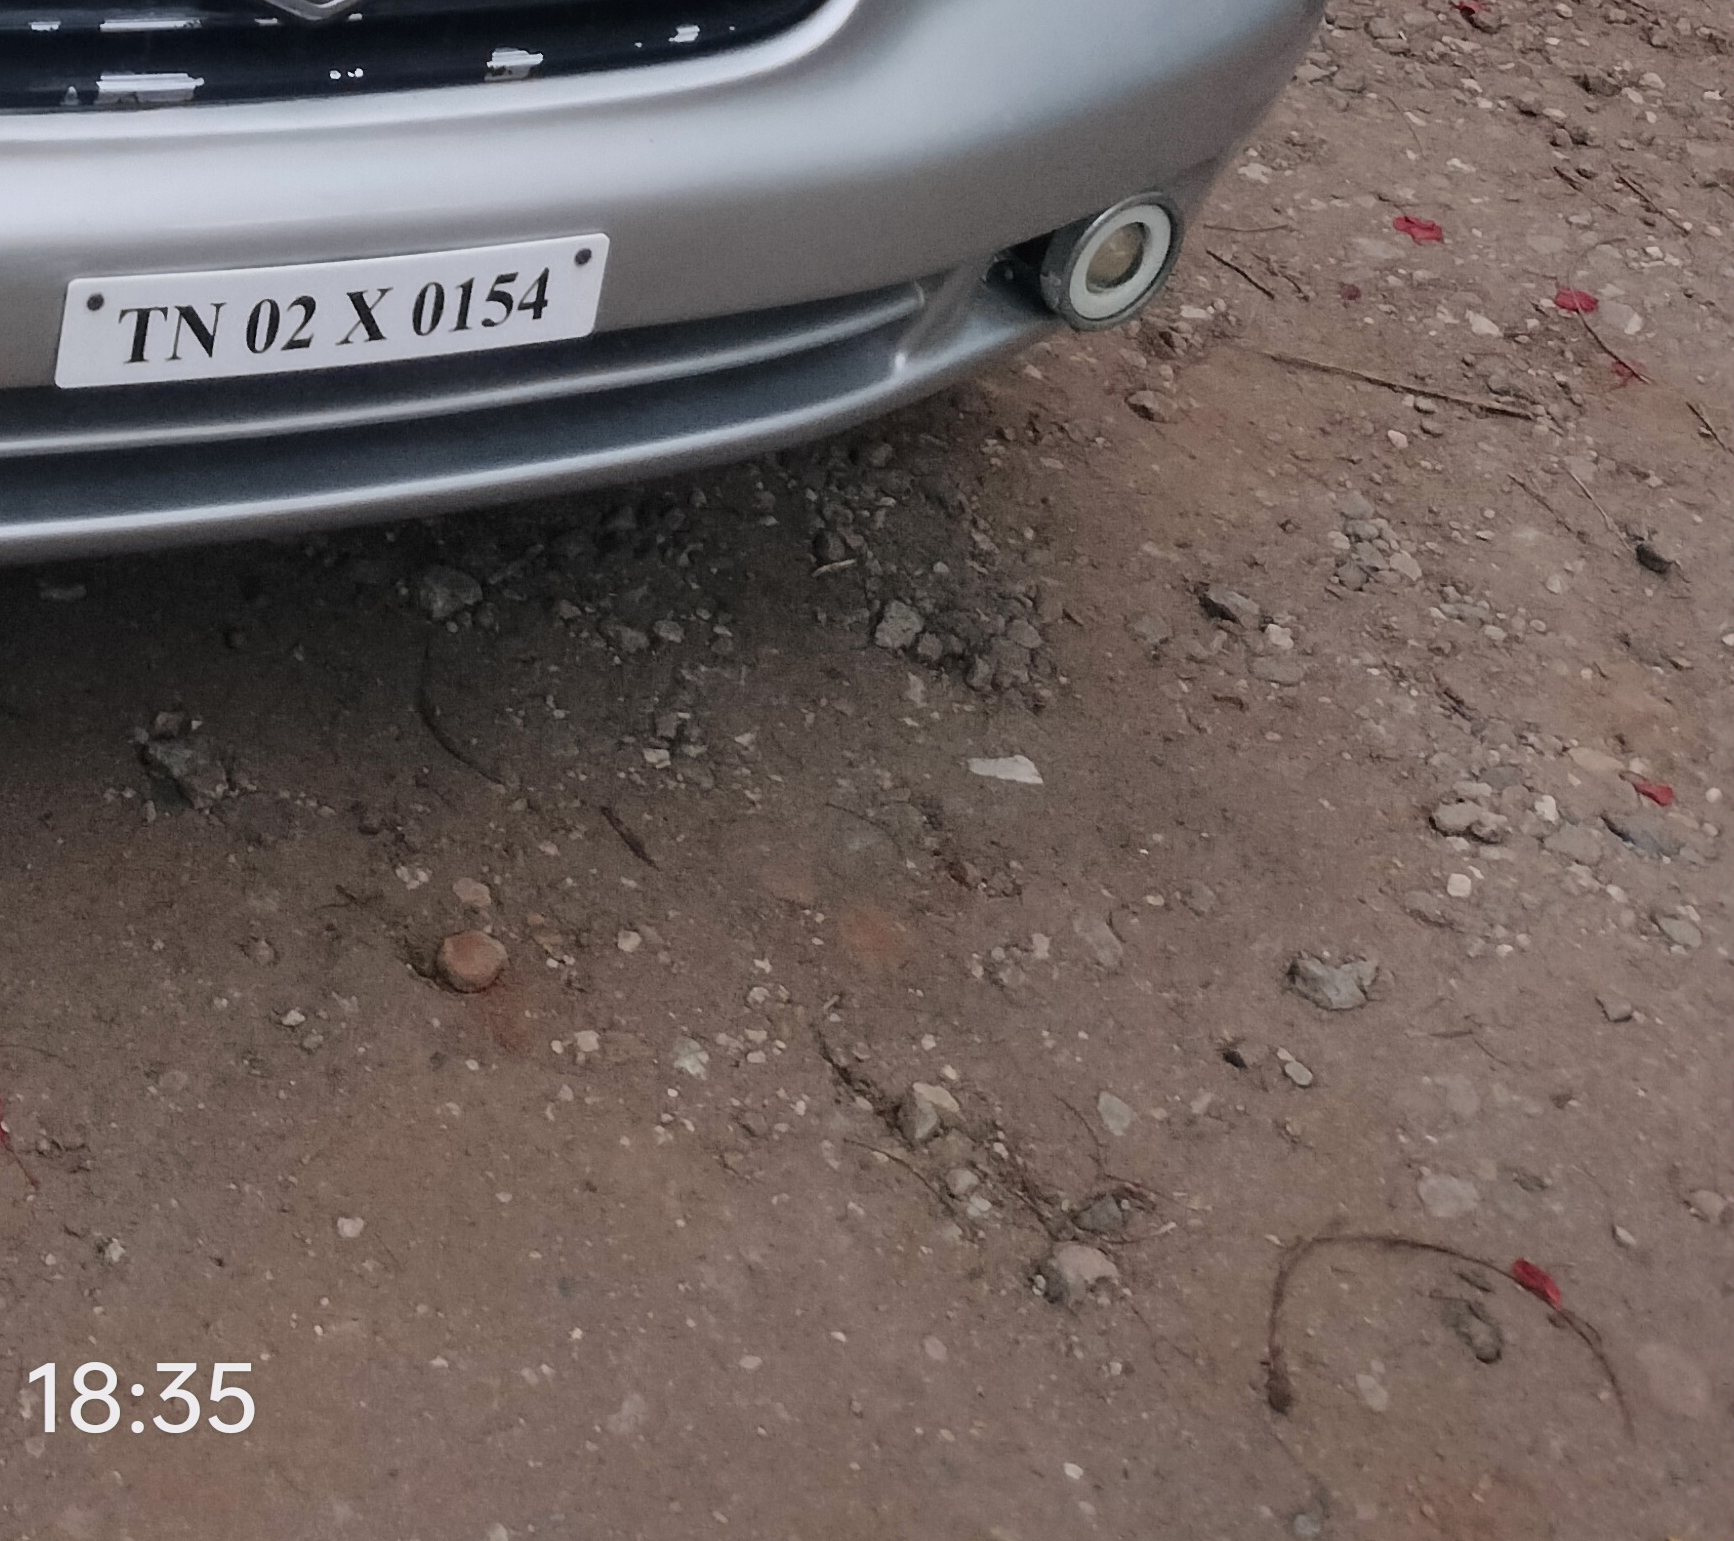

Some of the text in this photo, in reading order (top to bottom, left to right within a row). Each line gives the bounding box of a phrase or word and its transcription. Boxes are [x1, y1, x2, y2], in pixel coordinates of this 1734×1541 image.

[118, 267, 550, 364] TN 02 X 0154
